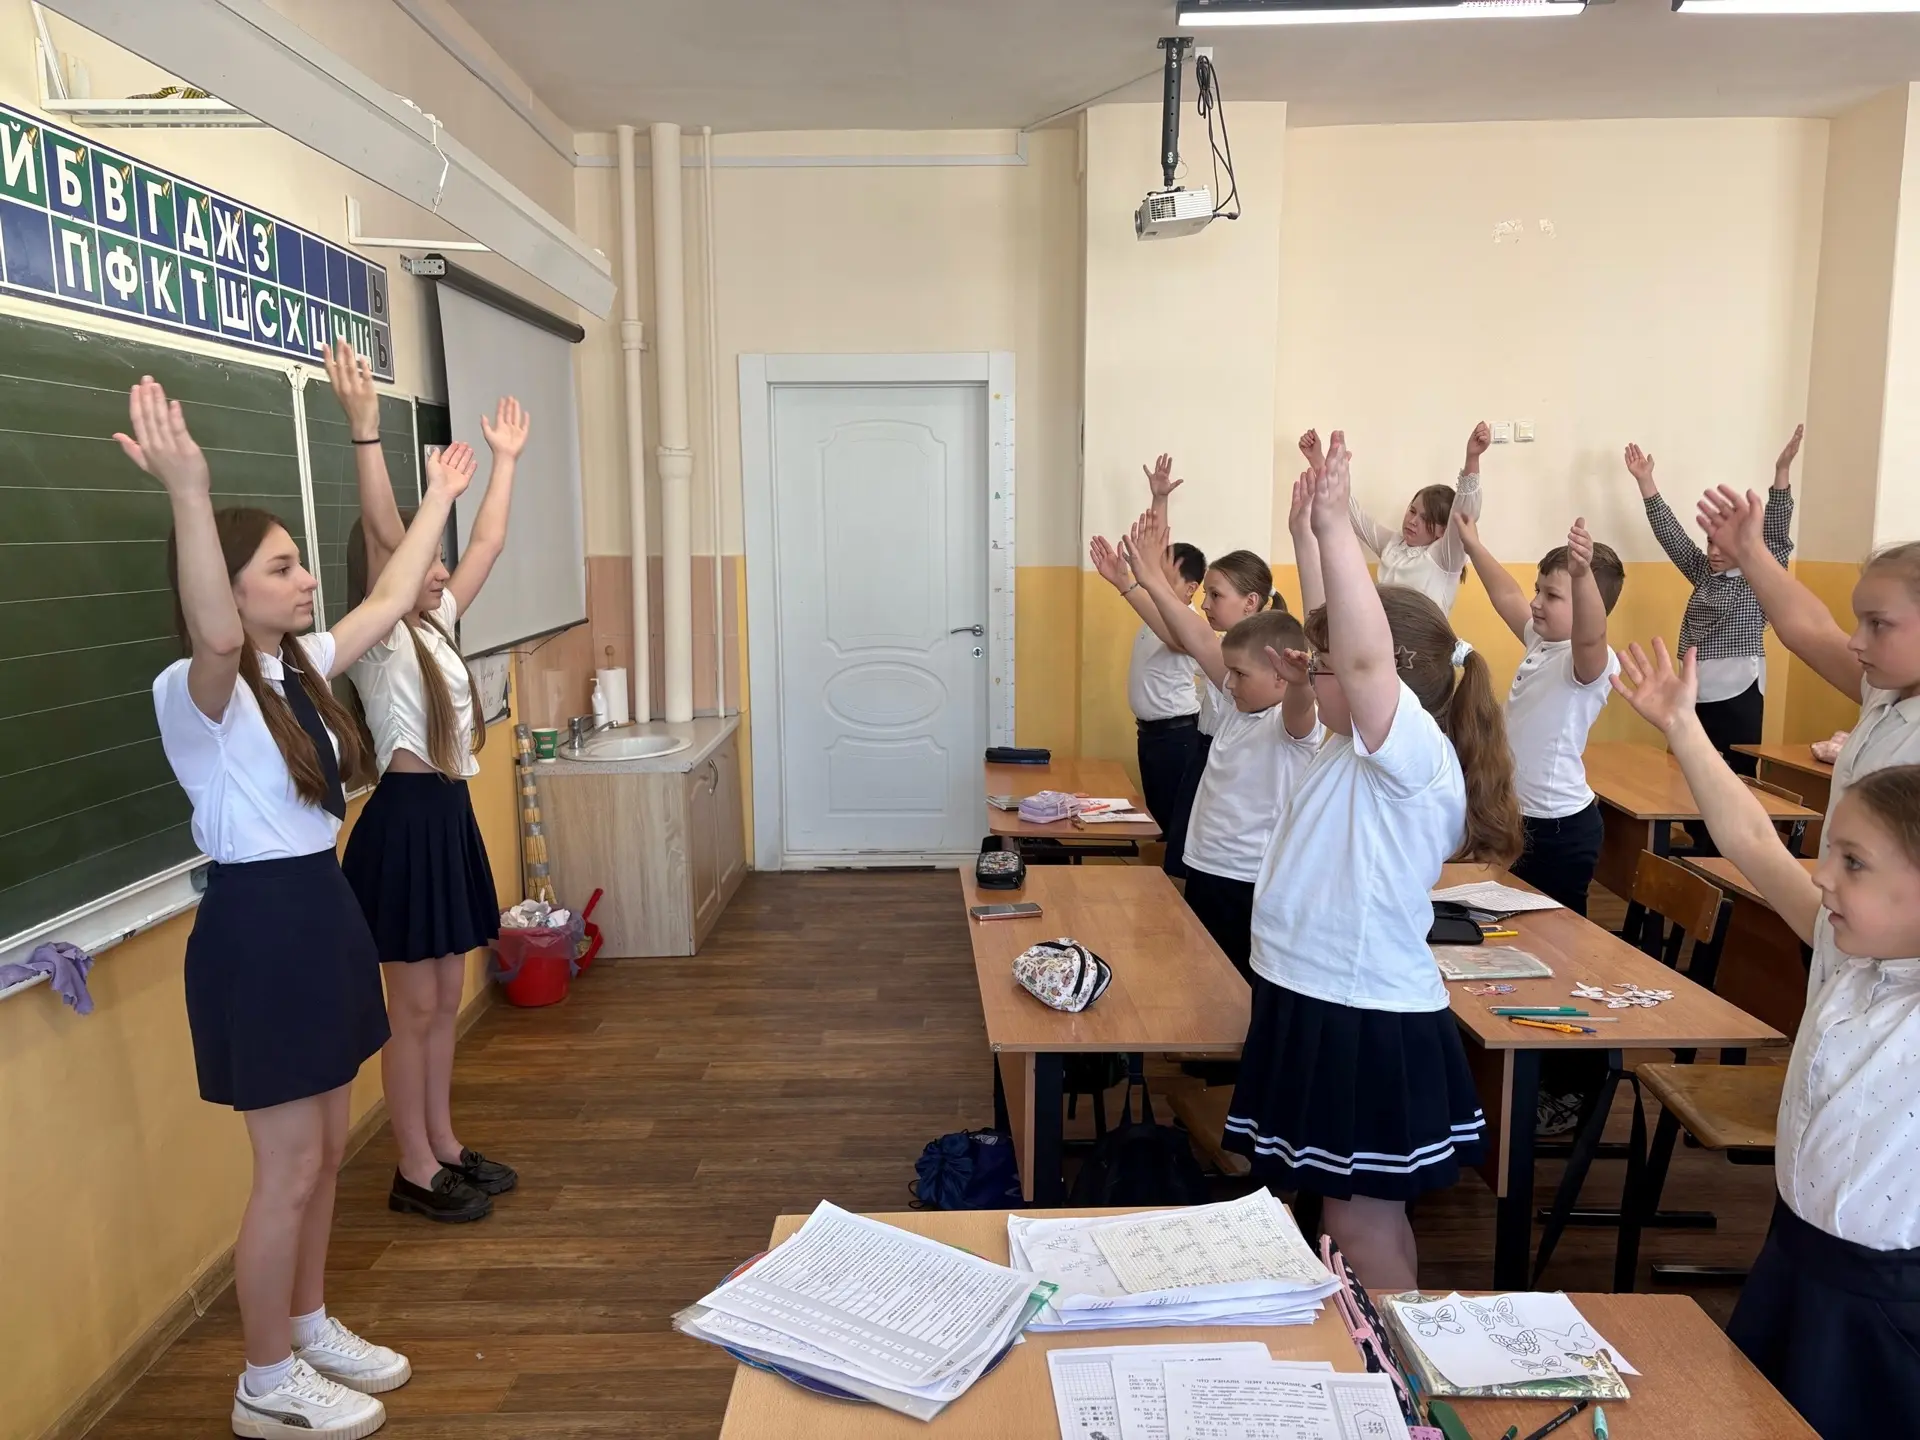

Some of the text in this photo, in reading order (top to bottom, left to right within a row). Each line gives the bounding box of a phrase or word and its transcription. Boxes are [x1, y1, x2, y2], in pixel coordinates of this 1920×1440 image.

[0, 121, 38, 195] Й
[56, 144, 83, 208] Б
[101, 162, 127, 223] В
[146, 180, 163, 236] Г
[183, 196, 209, 258] Д
[213, 205, 245, 265] Ж
[252, 222, 270, 272] З
[60, 228, 93, 293] П
[105, 244, 139, 301] Ф
[150, 255, 177, 314] К
[190, 268, 208, 321] Т
[218, 276, 251, 332] Ш
[255, 289, 278, 338] С
[284, 297, 305, 346] Х
[373, 327, 388, 369] Ъ
